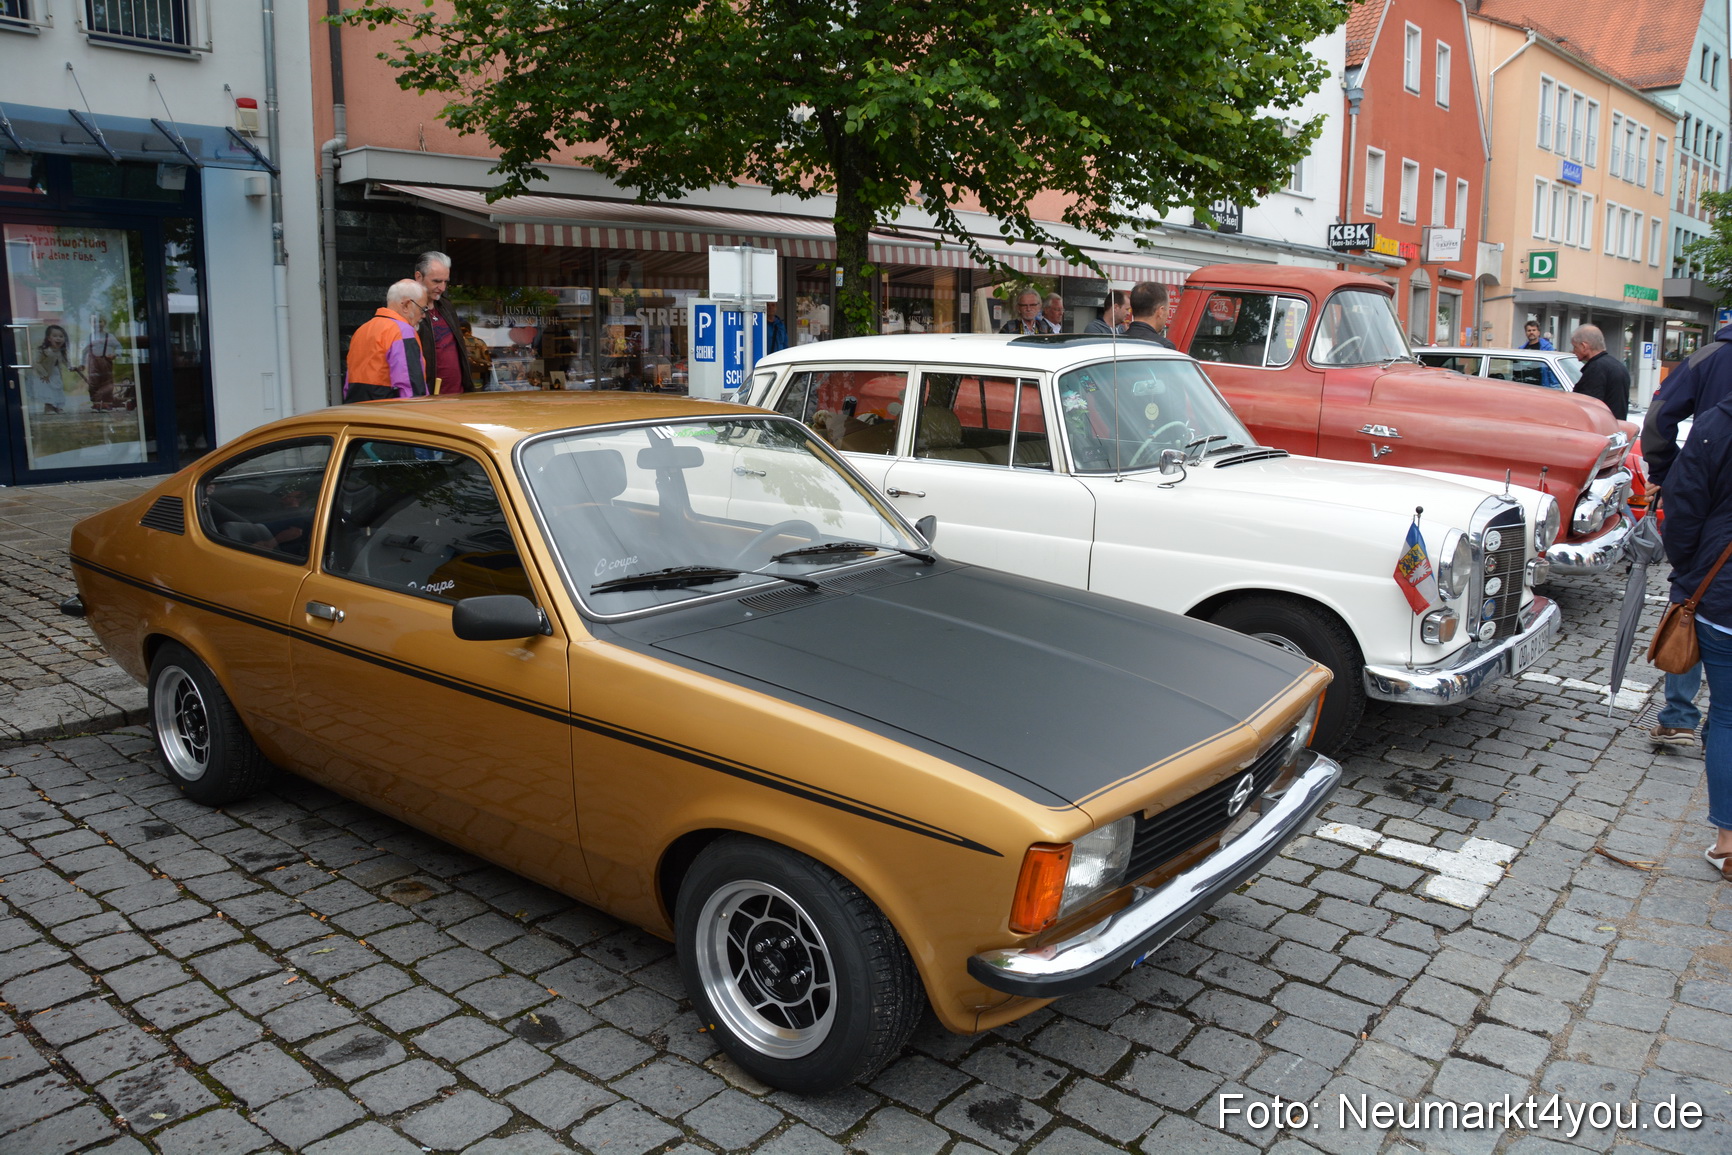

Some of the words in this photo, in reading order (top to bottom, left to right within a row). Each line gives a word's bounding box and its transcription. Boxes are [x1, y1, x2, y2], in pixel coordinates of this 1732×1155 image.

[1330, 224, 1370, 240] KBK
[24, 234, 107, 253] Verantwortung
[48, 249, 70, 261] deine
[1533, 256, 1553, 275] D
[505, 305, 526, 315] LUST
[526, 305, 544, 315] AUF
[698, 312, 712, 339] P
[728, 312, 759, 326] HIR
[696, 345, 714, 360] SCHEINE
[725, 369, 743, 385] SCH
[594, 558, 607, 577] C
[608, 554, 639, 573] coupe
